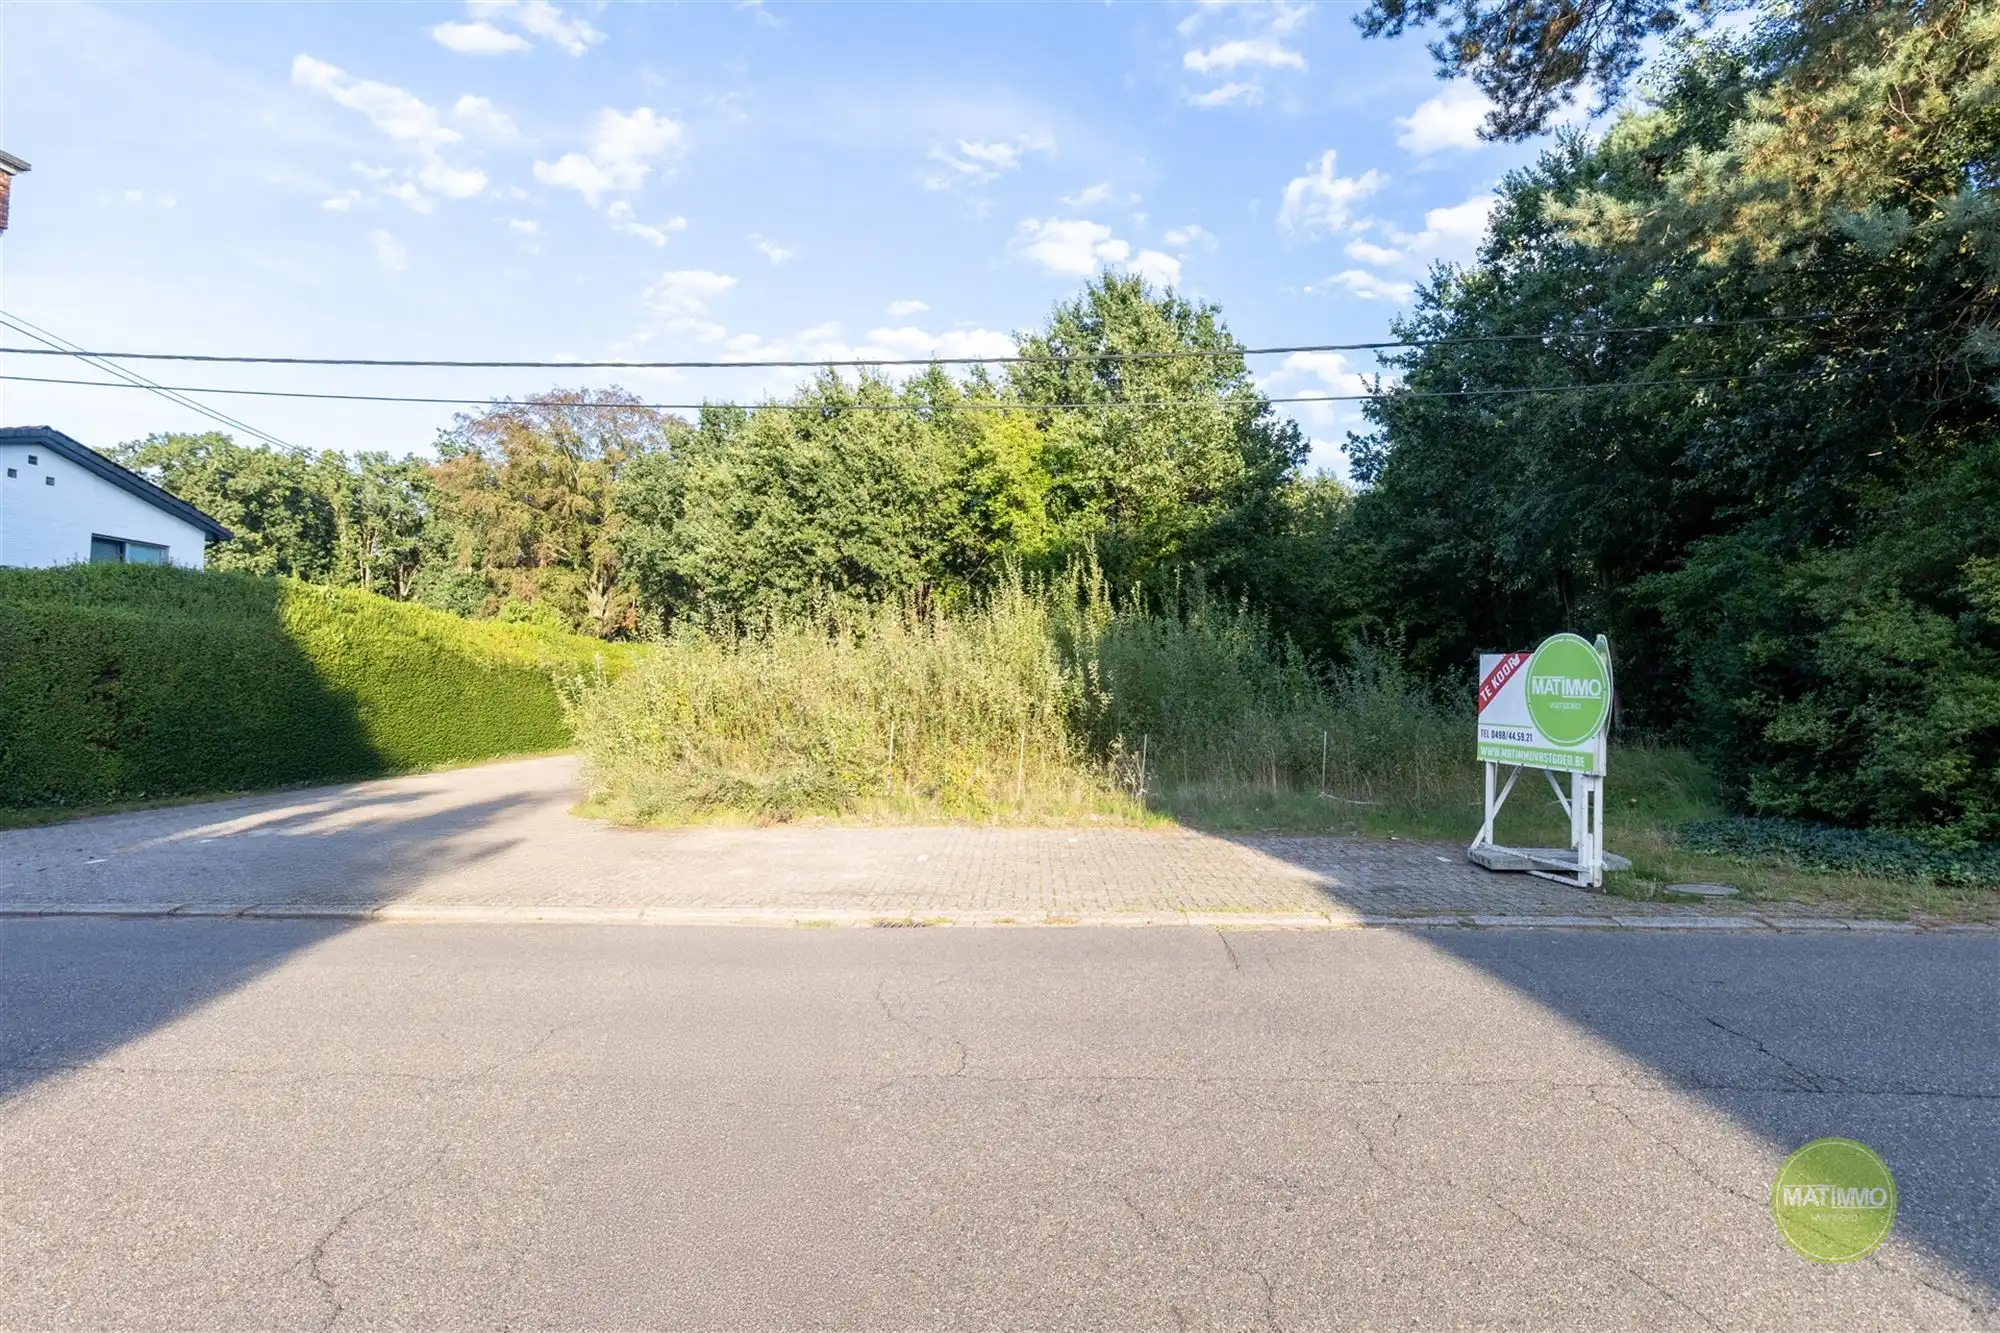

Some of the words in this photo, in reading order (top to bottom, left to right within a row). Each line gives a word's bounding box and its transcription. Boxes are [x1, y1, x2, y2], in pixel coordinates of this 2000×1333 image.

[1480, 685, 1493, 702] TE
[1532, 679, 1602, 697] MATIMMO
[1480, 729, 1490, 739] TEL
[1491, 730, 1533, 742] 0498/44.59.21
